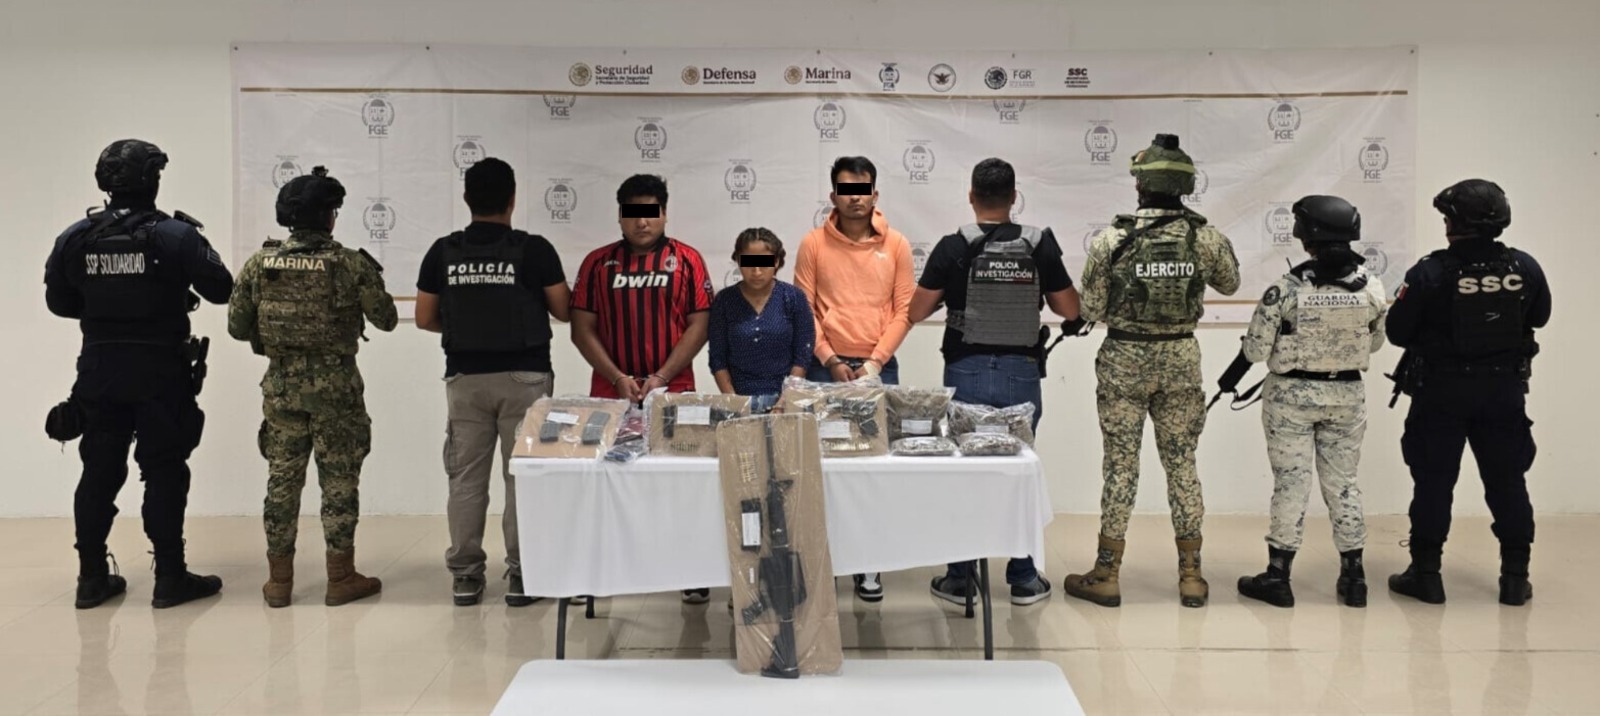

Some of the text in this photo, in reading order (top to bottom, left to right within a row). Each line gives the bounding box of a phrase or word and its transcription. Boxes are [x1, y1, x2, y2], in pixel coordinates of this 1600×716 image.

[595, 65, 653, 76] Seguridad
[703, 67, 757, 80] Defensa
[805, 67, 851, 80] Marina
[1013, 69, 1032, 80] FGR
[1067, 67, 1088, 76] SSC
[551, 106, 569, 116] FGE
[1000, 111, 1019, 120] FGE
[369, 125, 388, 135] FGE
[820, 129, 839, 139] FGE
[1274, 130, 1294, 140] FGE
[641, 149, 660, 159] FGE
[1091, 152, 1110, 162] FGE
[910, 171, 928, 181] FGE
[1364, 169, 1381, 179] FGE
[731, 190, 749, 200] FGE
[551, 210, 570, 220] FGE
[370, 229, 389, 239] FGE
[1273, 233, 1292, 243] FGE
[86, 252, 145, 275] SSP SOLIDARIDAD
[263, 256, 326, 271] MARINA
[448, 262, 515, 275] POLICÍA
[975, 268, 1033, 279] INVESTIGACIÓN
[1135, 262, 1195, 277] EJERCITO
[448, 273, 515, 285] DE INVESTIGACIÓN
[612, 271, 669, 289] bwin
[1458, 273, 1524, 294] SSC
